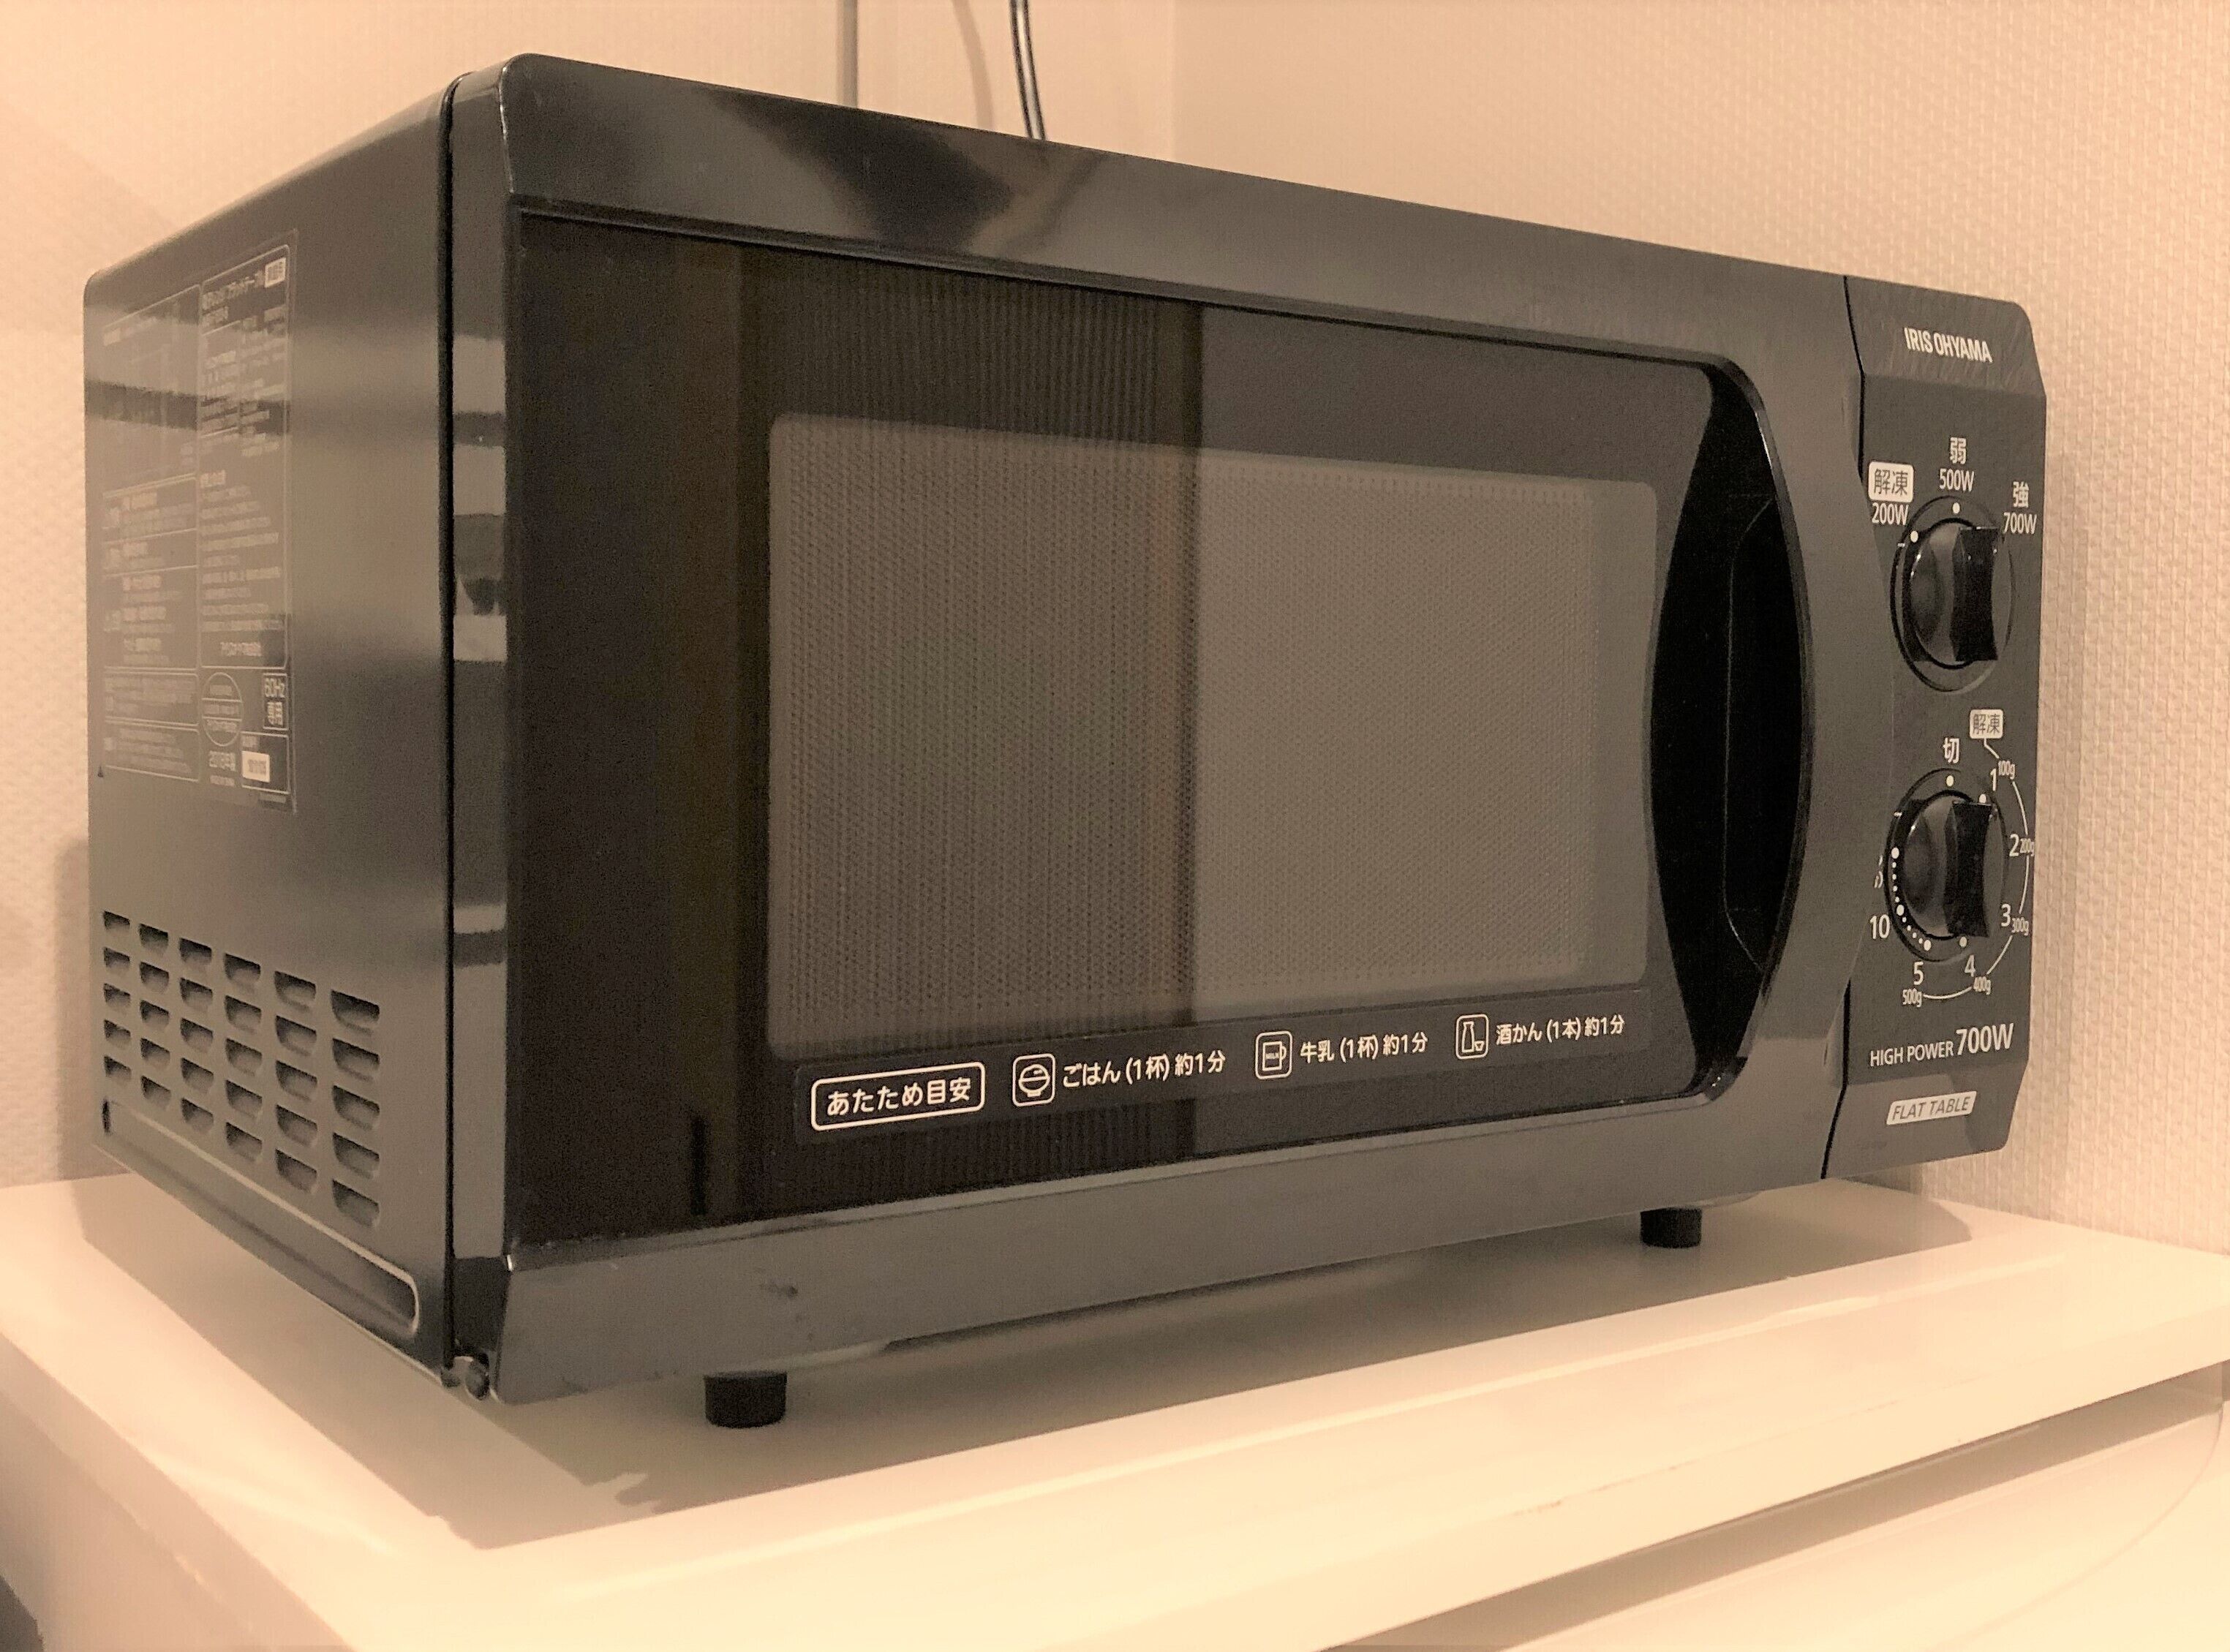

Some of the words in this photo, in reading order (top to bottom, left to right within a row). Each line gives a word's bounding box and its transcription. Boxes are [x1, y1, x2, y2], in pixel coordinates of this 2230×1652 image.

[1904, 327, 1933, 353] IRIS
[1933, 332, 1993, 363] OHYAMA
[1950, 437, 1967, 464] 弱
[1874, 468, 1908, 497] 解凍
[1939, 468, 1975, 492] 500W
[2012, 481, 2030, 508] 強
[1872, 502, 1910, 525] 200W
[2003, 512, 2037, 535] 700W
[1973, 713, 2000, 735] 解凍
[1943, 737, 1960, 764] 切
[1989, 768, 1997, 791] 1
[1997, 760, 2016, 780] 100g
[2008, 833, 2019, 857] 2
[2020, 838, 2035, 857] 200g
[1869, 914, 1891, 940] 10
[2000, 903, 2011, 927] 3
[2011, 916, 2030, 936] 300g
[1913, 961, 1924, 986] 5
[1964, 954, 1975, 977] 4
[1973, 976, 1992, 995] 400g
[1902, 988, 1923, 1008] 500g
[1870, 1046, 1904, 1067] HIGH
[1907, 1040, 1954, 1063] POWER
[1956, 1022, 2014, 1055] 700W
[827, 1076, 971, 1117] あたため目安
[1892, 1102, 1926, 1120] FLAT
[1929, 1097, 1970, 1113] TABLE
